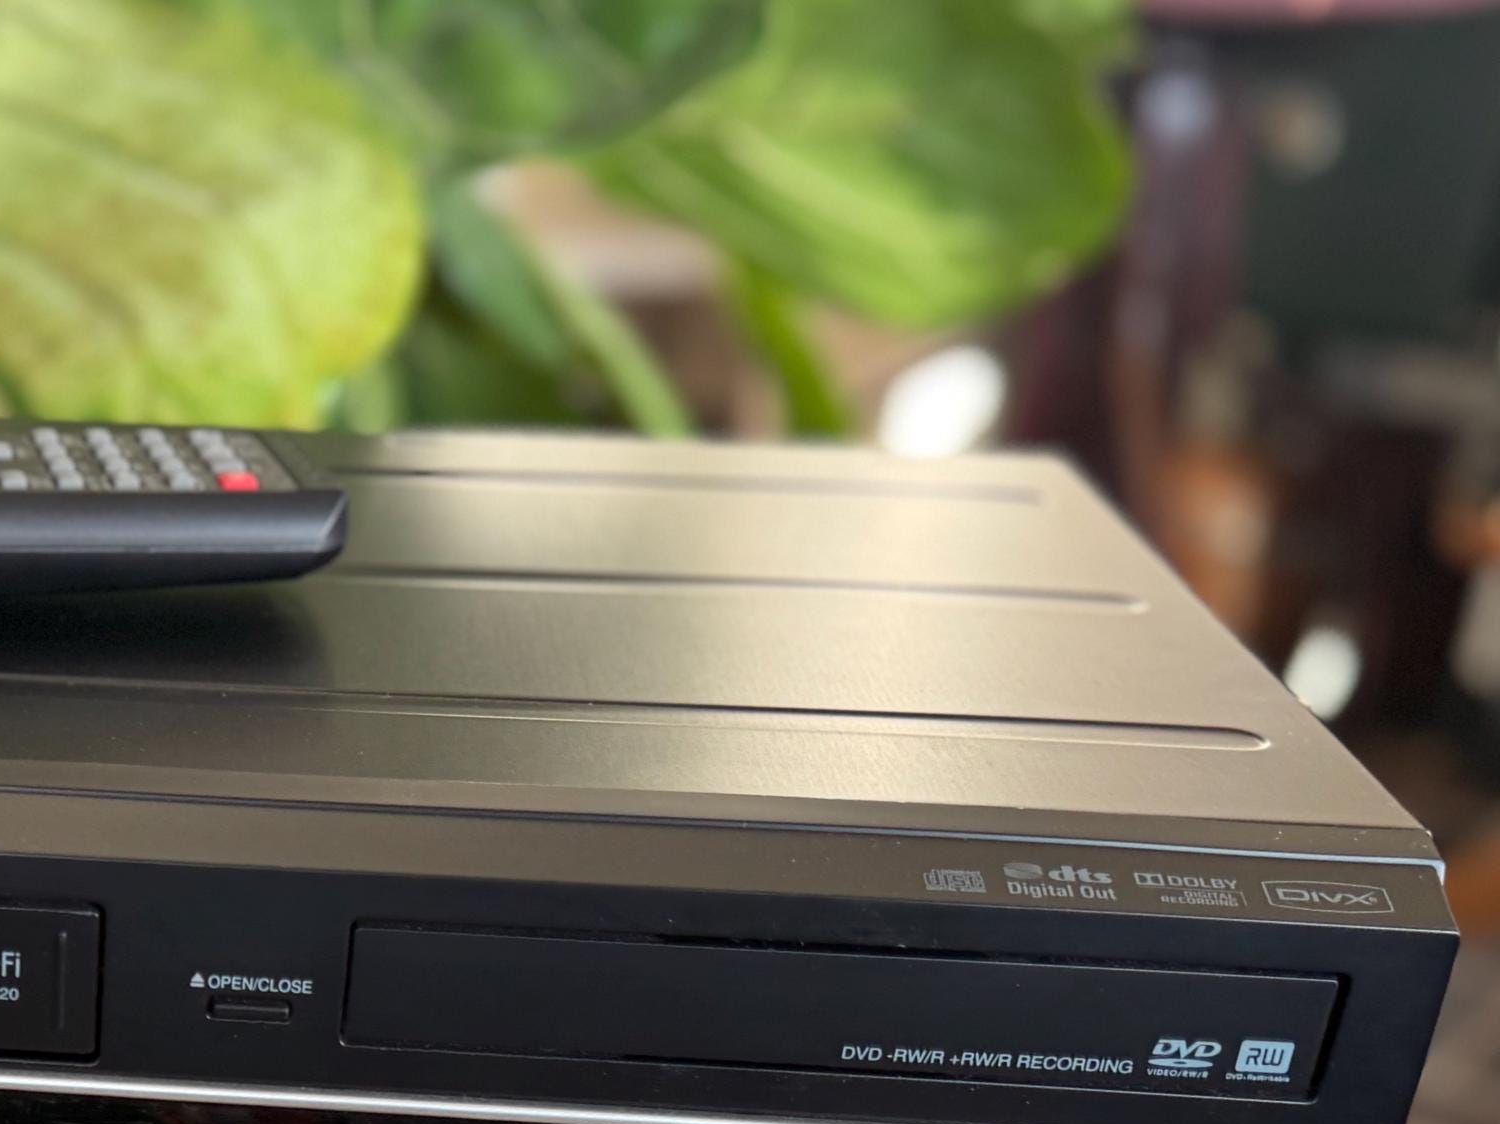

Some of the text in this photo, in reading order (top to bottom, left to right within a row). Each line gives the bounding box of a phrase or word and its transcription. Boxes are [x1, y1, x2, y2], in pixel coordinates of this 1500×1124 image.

[1048, 865, 1112, 884] dts
[1167, 875, 1237, 889] DOLBY
[1007, 881, 1116, 900] Digital Out
[207, 974, 313, 995] OPEN/CLOSE
[1152, 1039, 1222, 1058] DVD
[1245, 1047, 1285, 1066] RW
[841, 1046, 1134, 1075] DVD -RW/R +RW/R RECORDING
